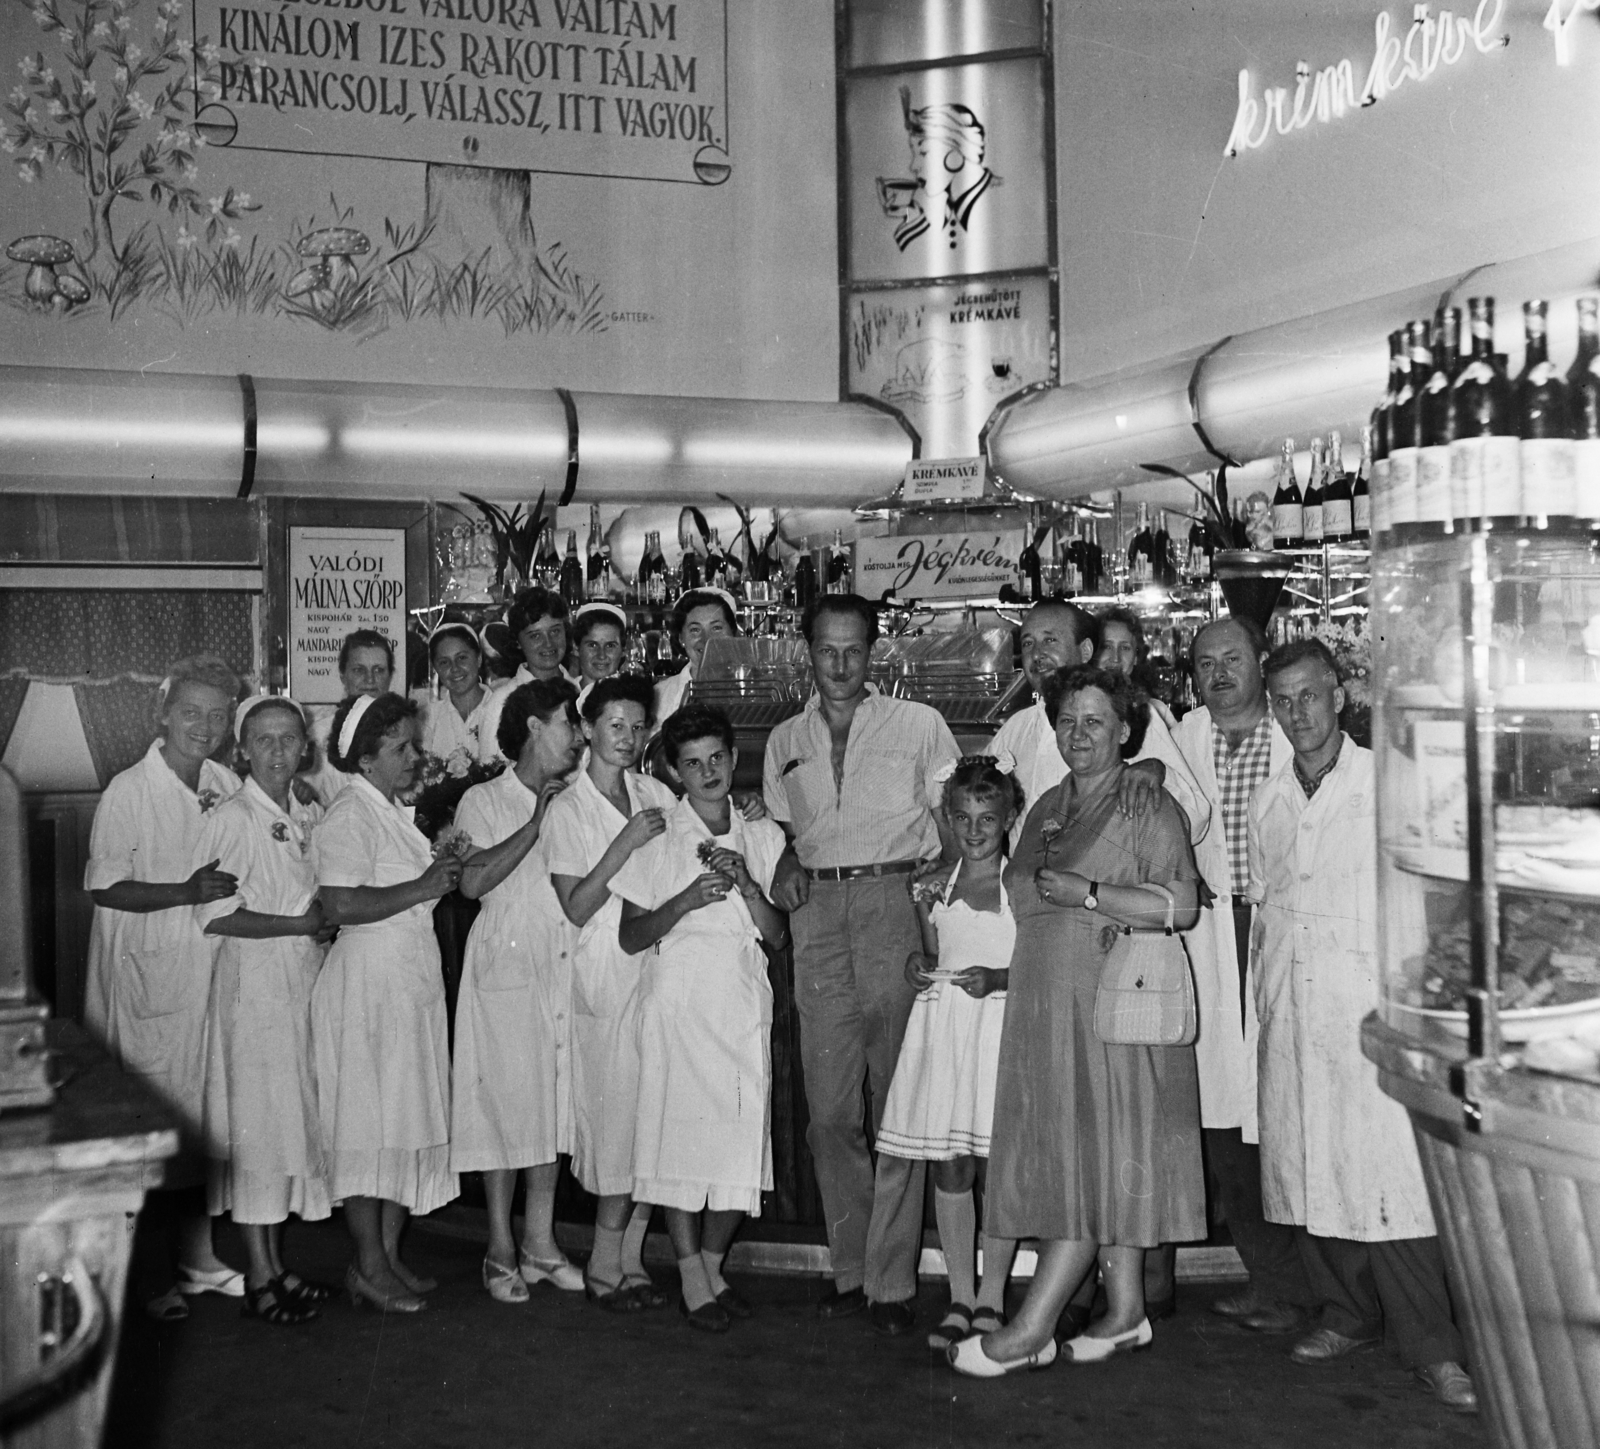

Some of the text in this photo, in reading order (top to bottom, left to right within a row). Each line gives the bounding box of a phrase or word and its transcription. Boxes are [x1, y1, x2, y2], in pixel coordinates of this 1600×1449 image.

[219, 4, 360, 62] KINÁLOM
[459, 32, 587, 85] RAKOTT
[593, 40, 697, 93] TÁLAM
[219, 60, 417, 124] PARANCSOLJ,
[420, 74, 551, 135] VÁLASSZ,
[557, 92, 606, 134] ITT
[309, 550, 384, 572] VALÓDI
[893, 537, 1020, 591] Jégkrém
[307, 612, 352, 622] KISPOHÁR
[307, 626, 330, 634] NAGY
[307, 668, 331, 676] NAGY
